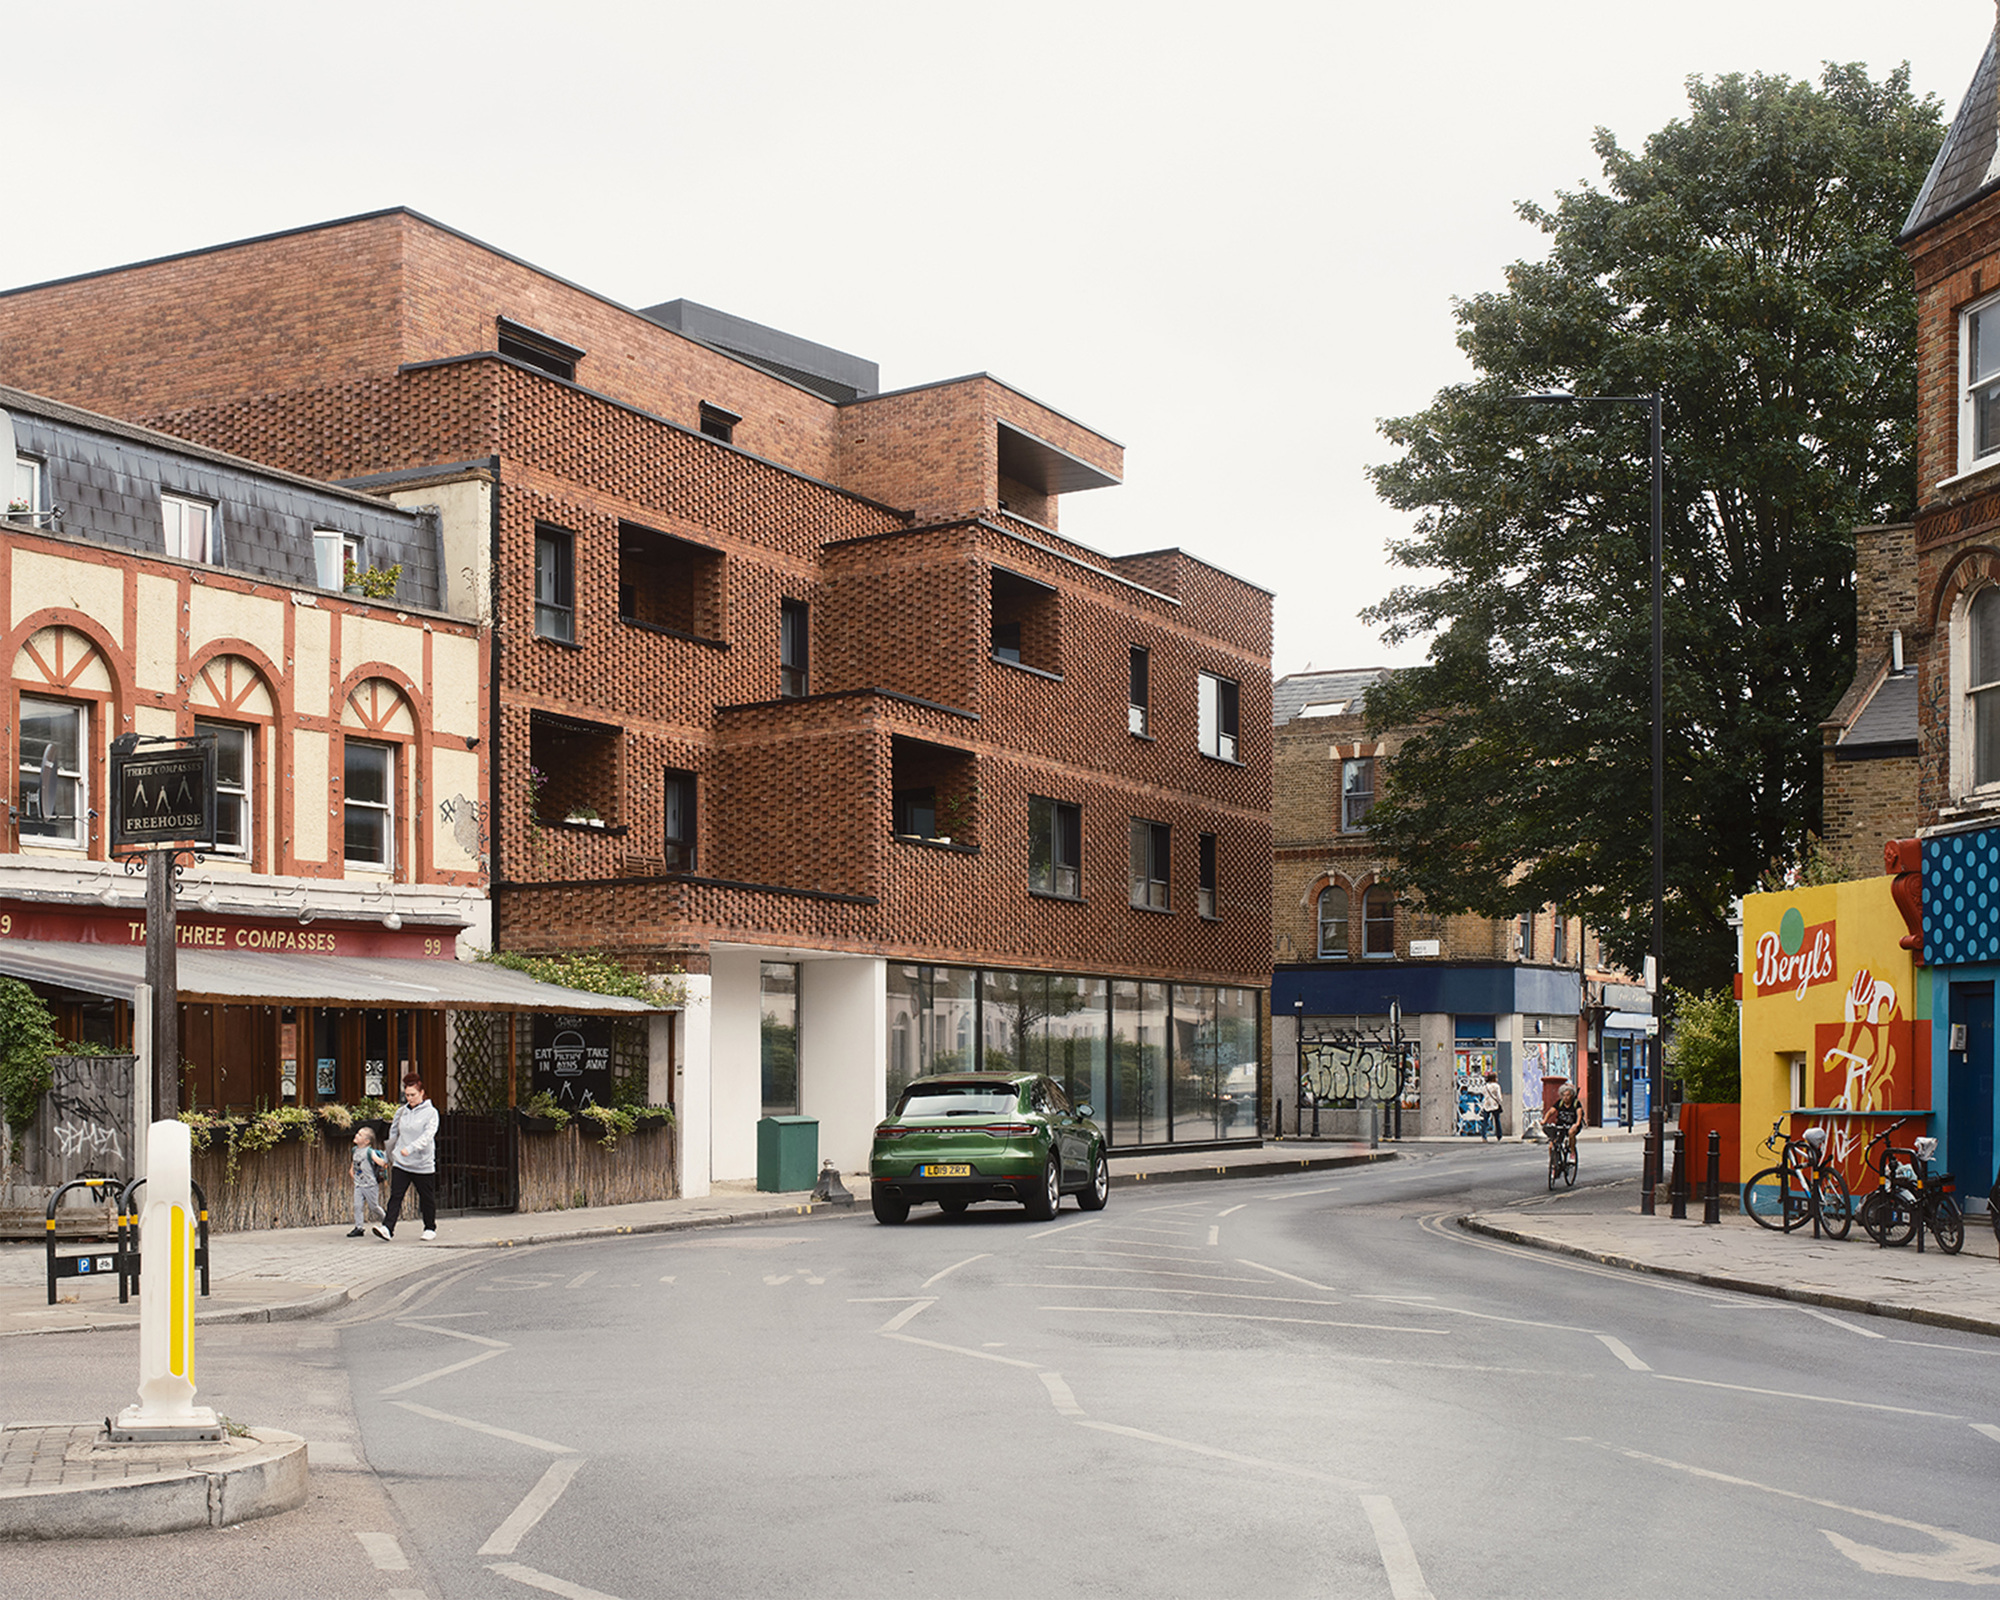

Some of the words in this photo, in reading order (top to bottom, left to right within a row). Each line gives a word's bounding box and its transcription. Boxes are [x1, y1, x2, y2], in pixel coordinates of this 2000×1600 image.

[126, 766, 153, 777] THREE
[154, 762, 202, 775] COMPASSES
[126, 814, 202, 830] FREEHOUSE
[128, 922, 147, 941] TH
[175, 925, 226, 946] THREE
[235, 929, 335, 951] COMPASSES
[424, 938, 442, 955] 99
[1753, 929, 1832, 1001] Beryl's
[534, 1048, 552, 1059] EAT
[586, 1048, 609, 1057] TAKE
[539, 1061, 550, 1071] IN
[585, 1060, 607, 1070] AWAY
[81, 1260, 88, 1271] P
